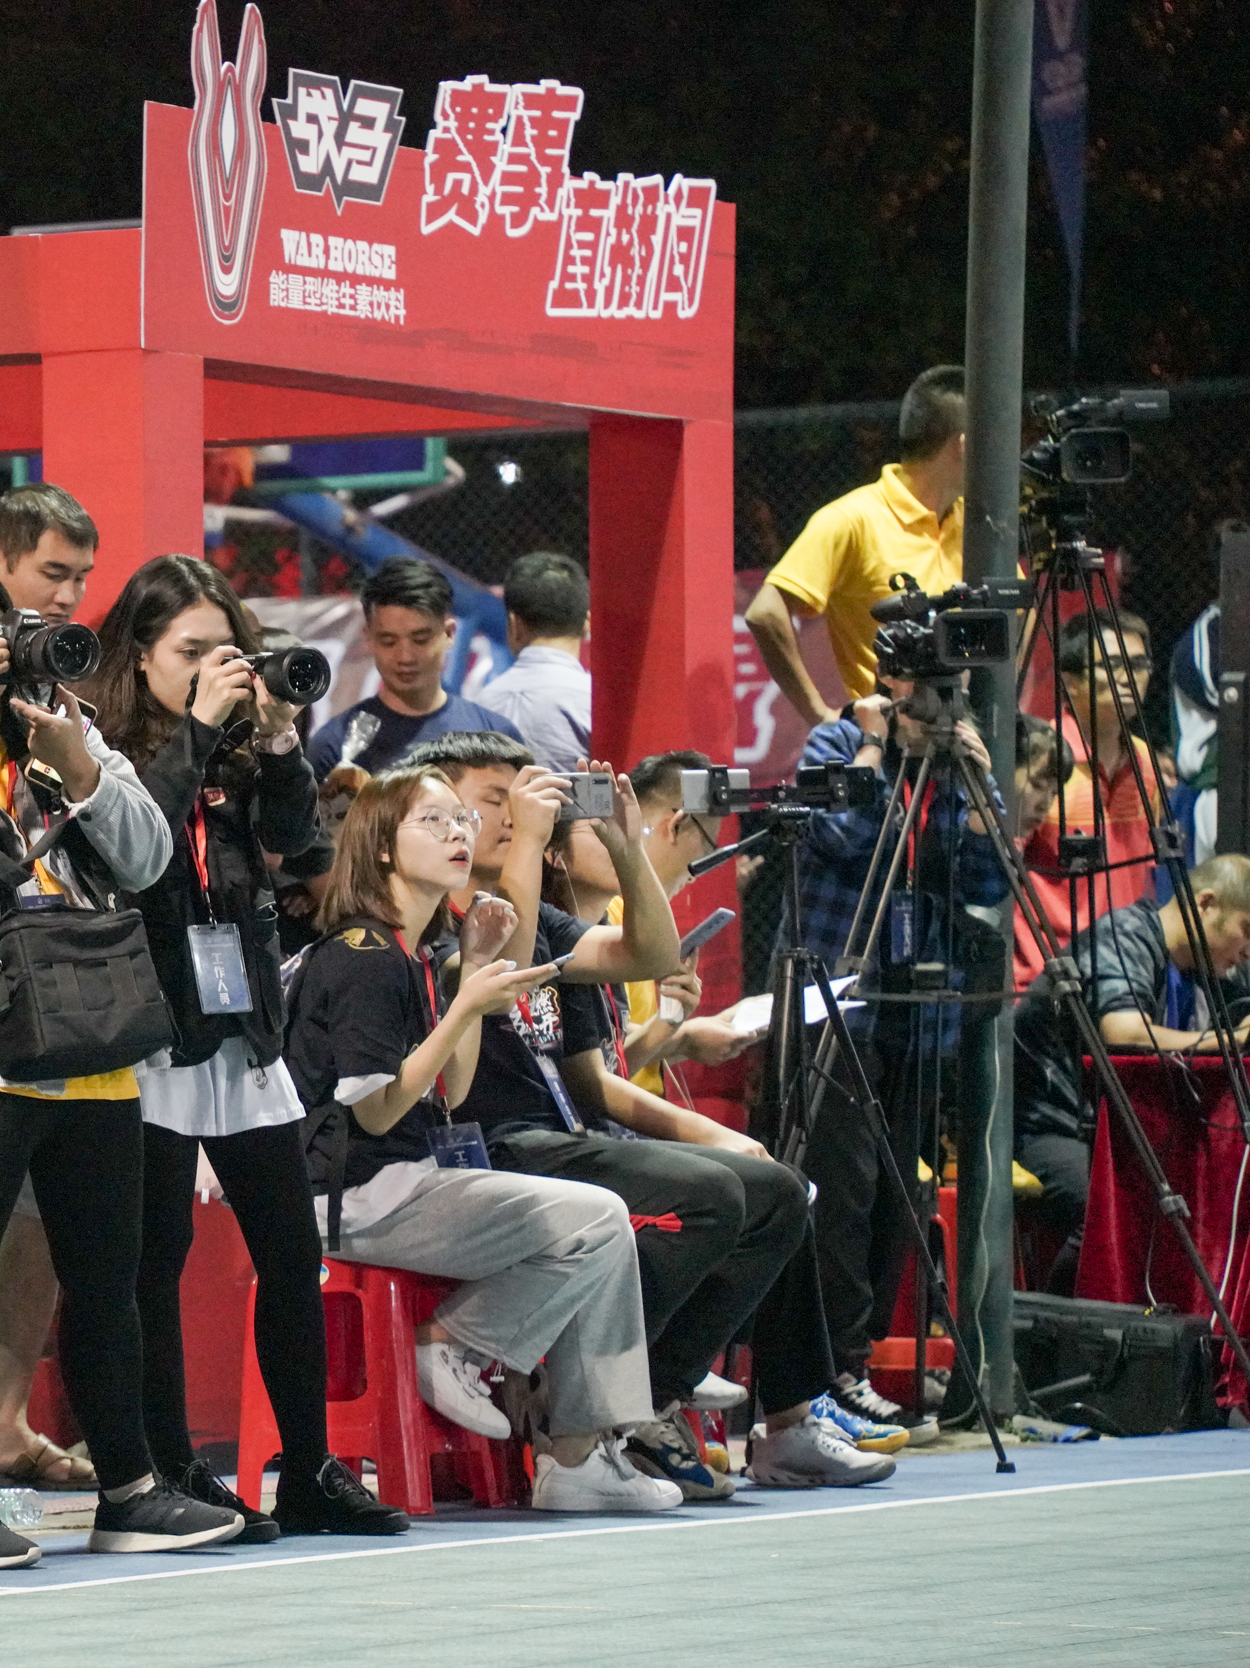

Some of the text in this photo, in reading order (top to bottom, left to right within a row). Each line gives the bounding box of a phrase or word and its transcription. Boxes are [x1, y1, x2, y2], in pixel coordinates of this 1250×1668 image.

[280, 228, 396, 280] WAR HORSE
[269, 270, 406, 325] 能量型维生素饮料
[211, 952, 230, 1006] 工作人员
